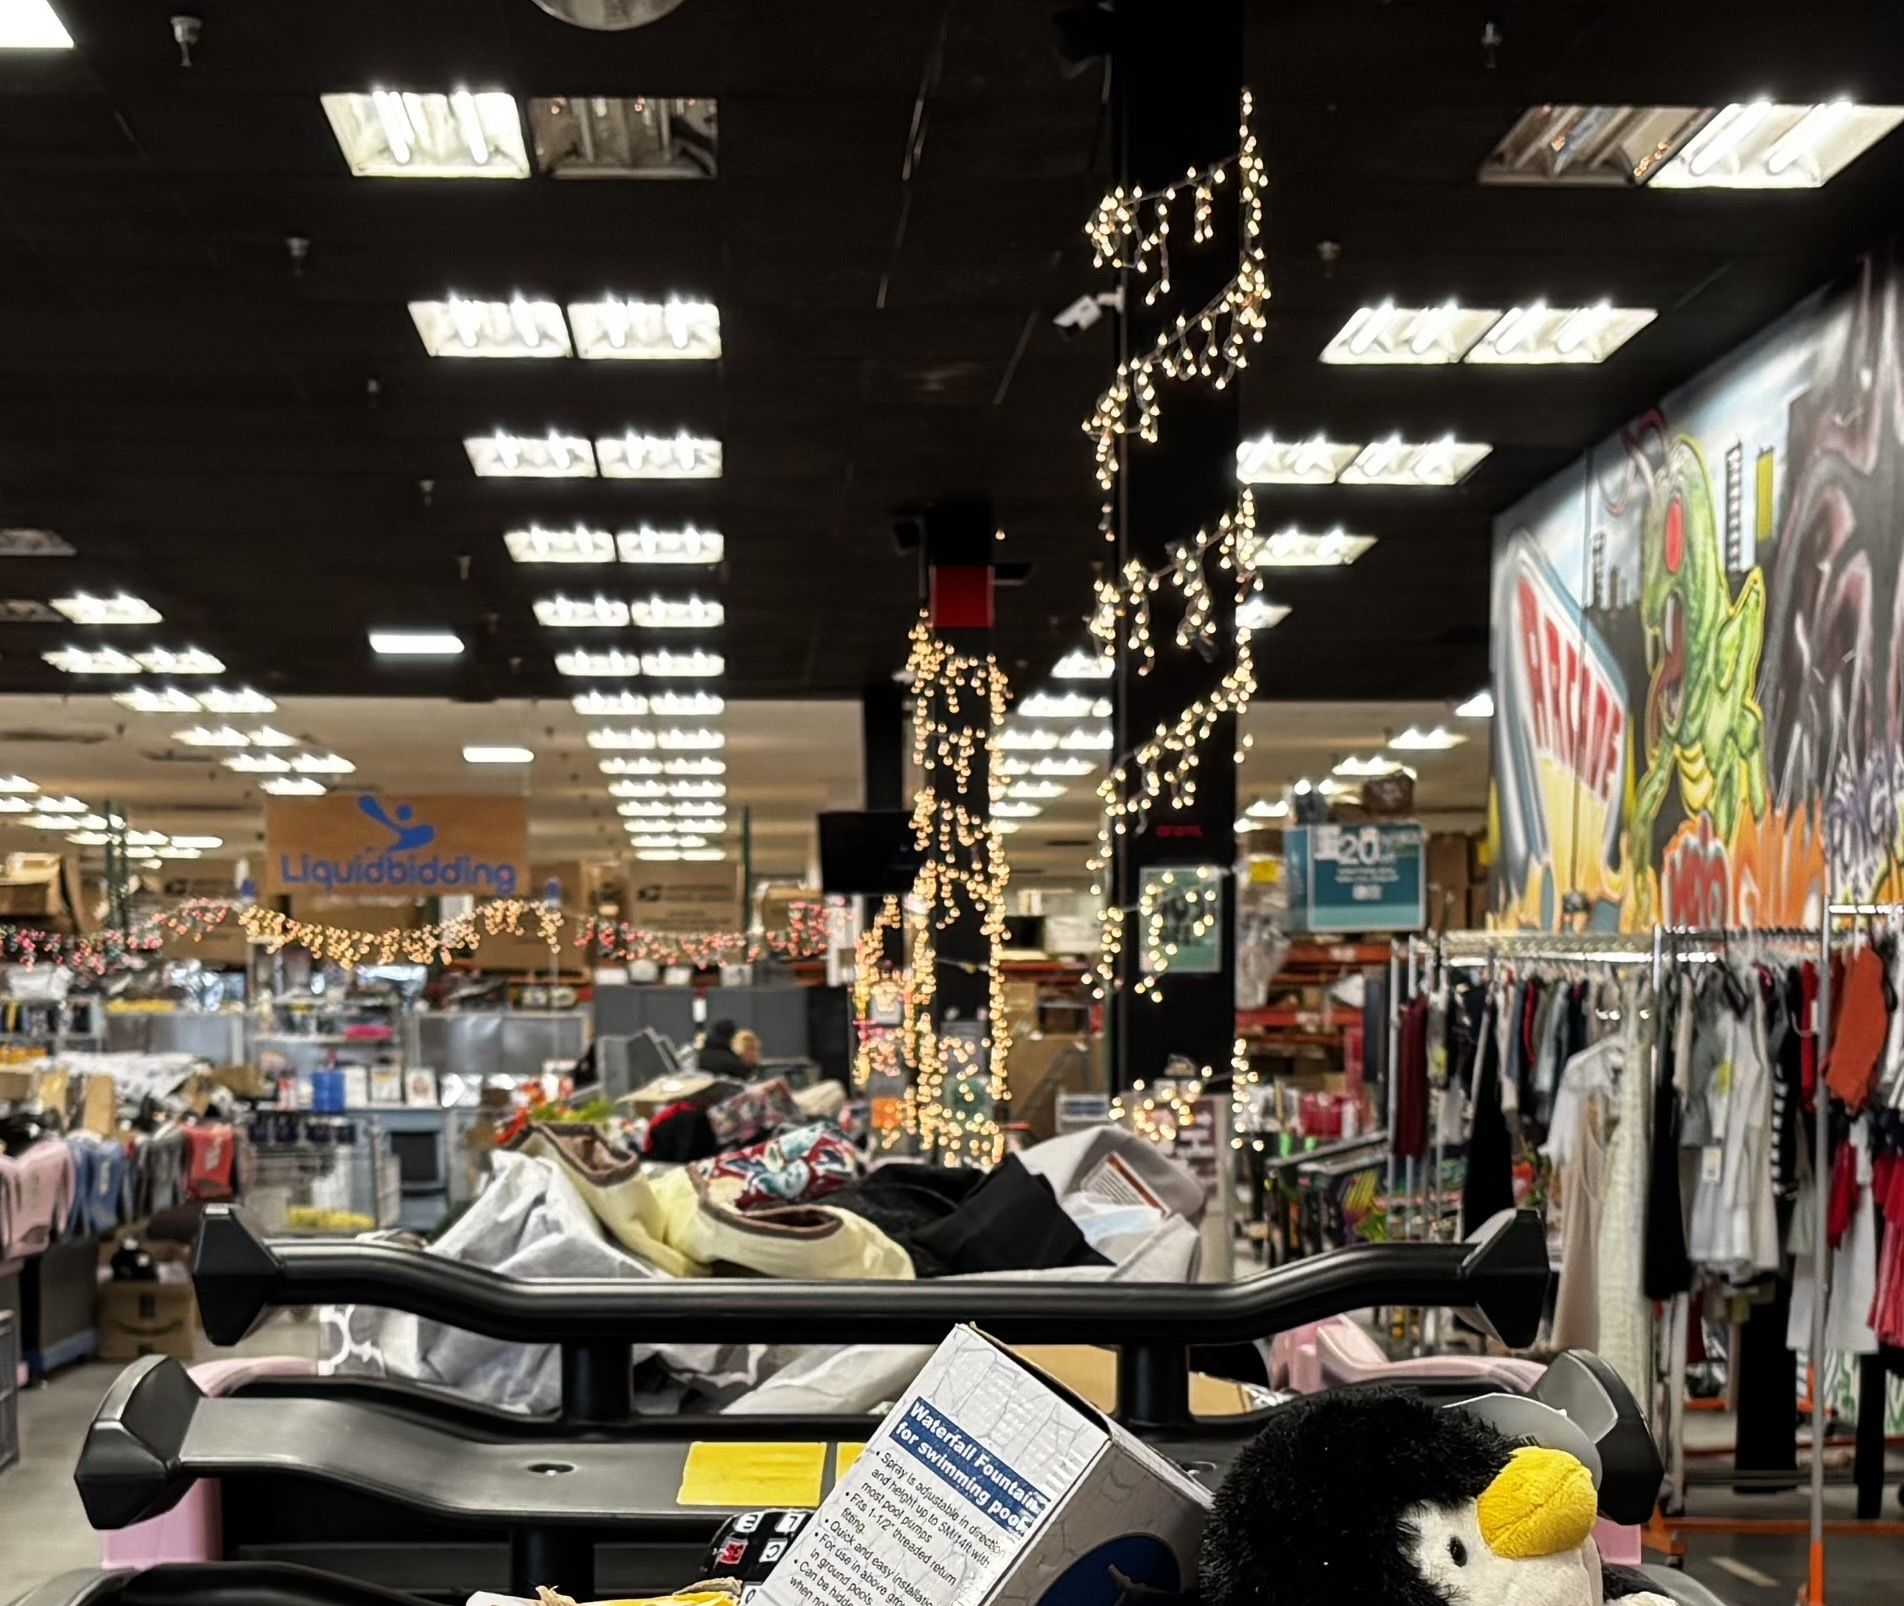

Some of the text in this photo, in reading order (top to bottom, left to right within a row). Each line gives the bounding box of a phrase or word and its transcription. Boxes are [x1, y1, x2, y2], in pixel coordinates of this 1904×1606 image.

[280, 852, 517, 896] Liquidbidding
[906, 1402, 978, 1461] Waterfall
[878, 1452, 909, 1479] Spray
[913, 1481, 961, 1521] adjustable
[958, 1516, 970, 1529] in
[894, 1423, 993, 1506] for swimming
[849, 1494, 868, 1512] Fits
[890, 1528, 938, 1568] threaded
[933, 1563, 957, 1585] return
[860, 1482, 933, 1543] most pool pumps
[871, 1468, 991, 1567] and height up to with
[798, 1561, 819, 1580] Can
[816, 1577, 830, 1590] be
[817, 1557, 851, 1586] ground
[818, 1535, 836, 1552] For
[834, 1548, 852, 1565] use
[850, 1561, 862, 1572] in
[859, 1569, 889, 1595] above
[828, 1521, 856, 1545] Quick
[853, 1542, 872, 1560] and
[869, 1556, 894, 1579] easy
[787, 1577, 814, 1600] when
